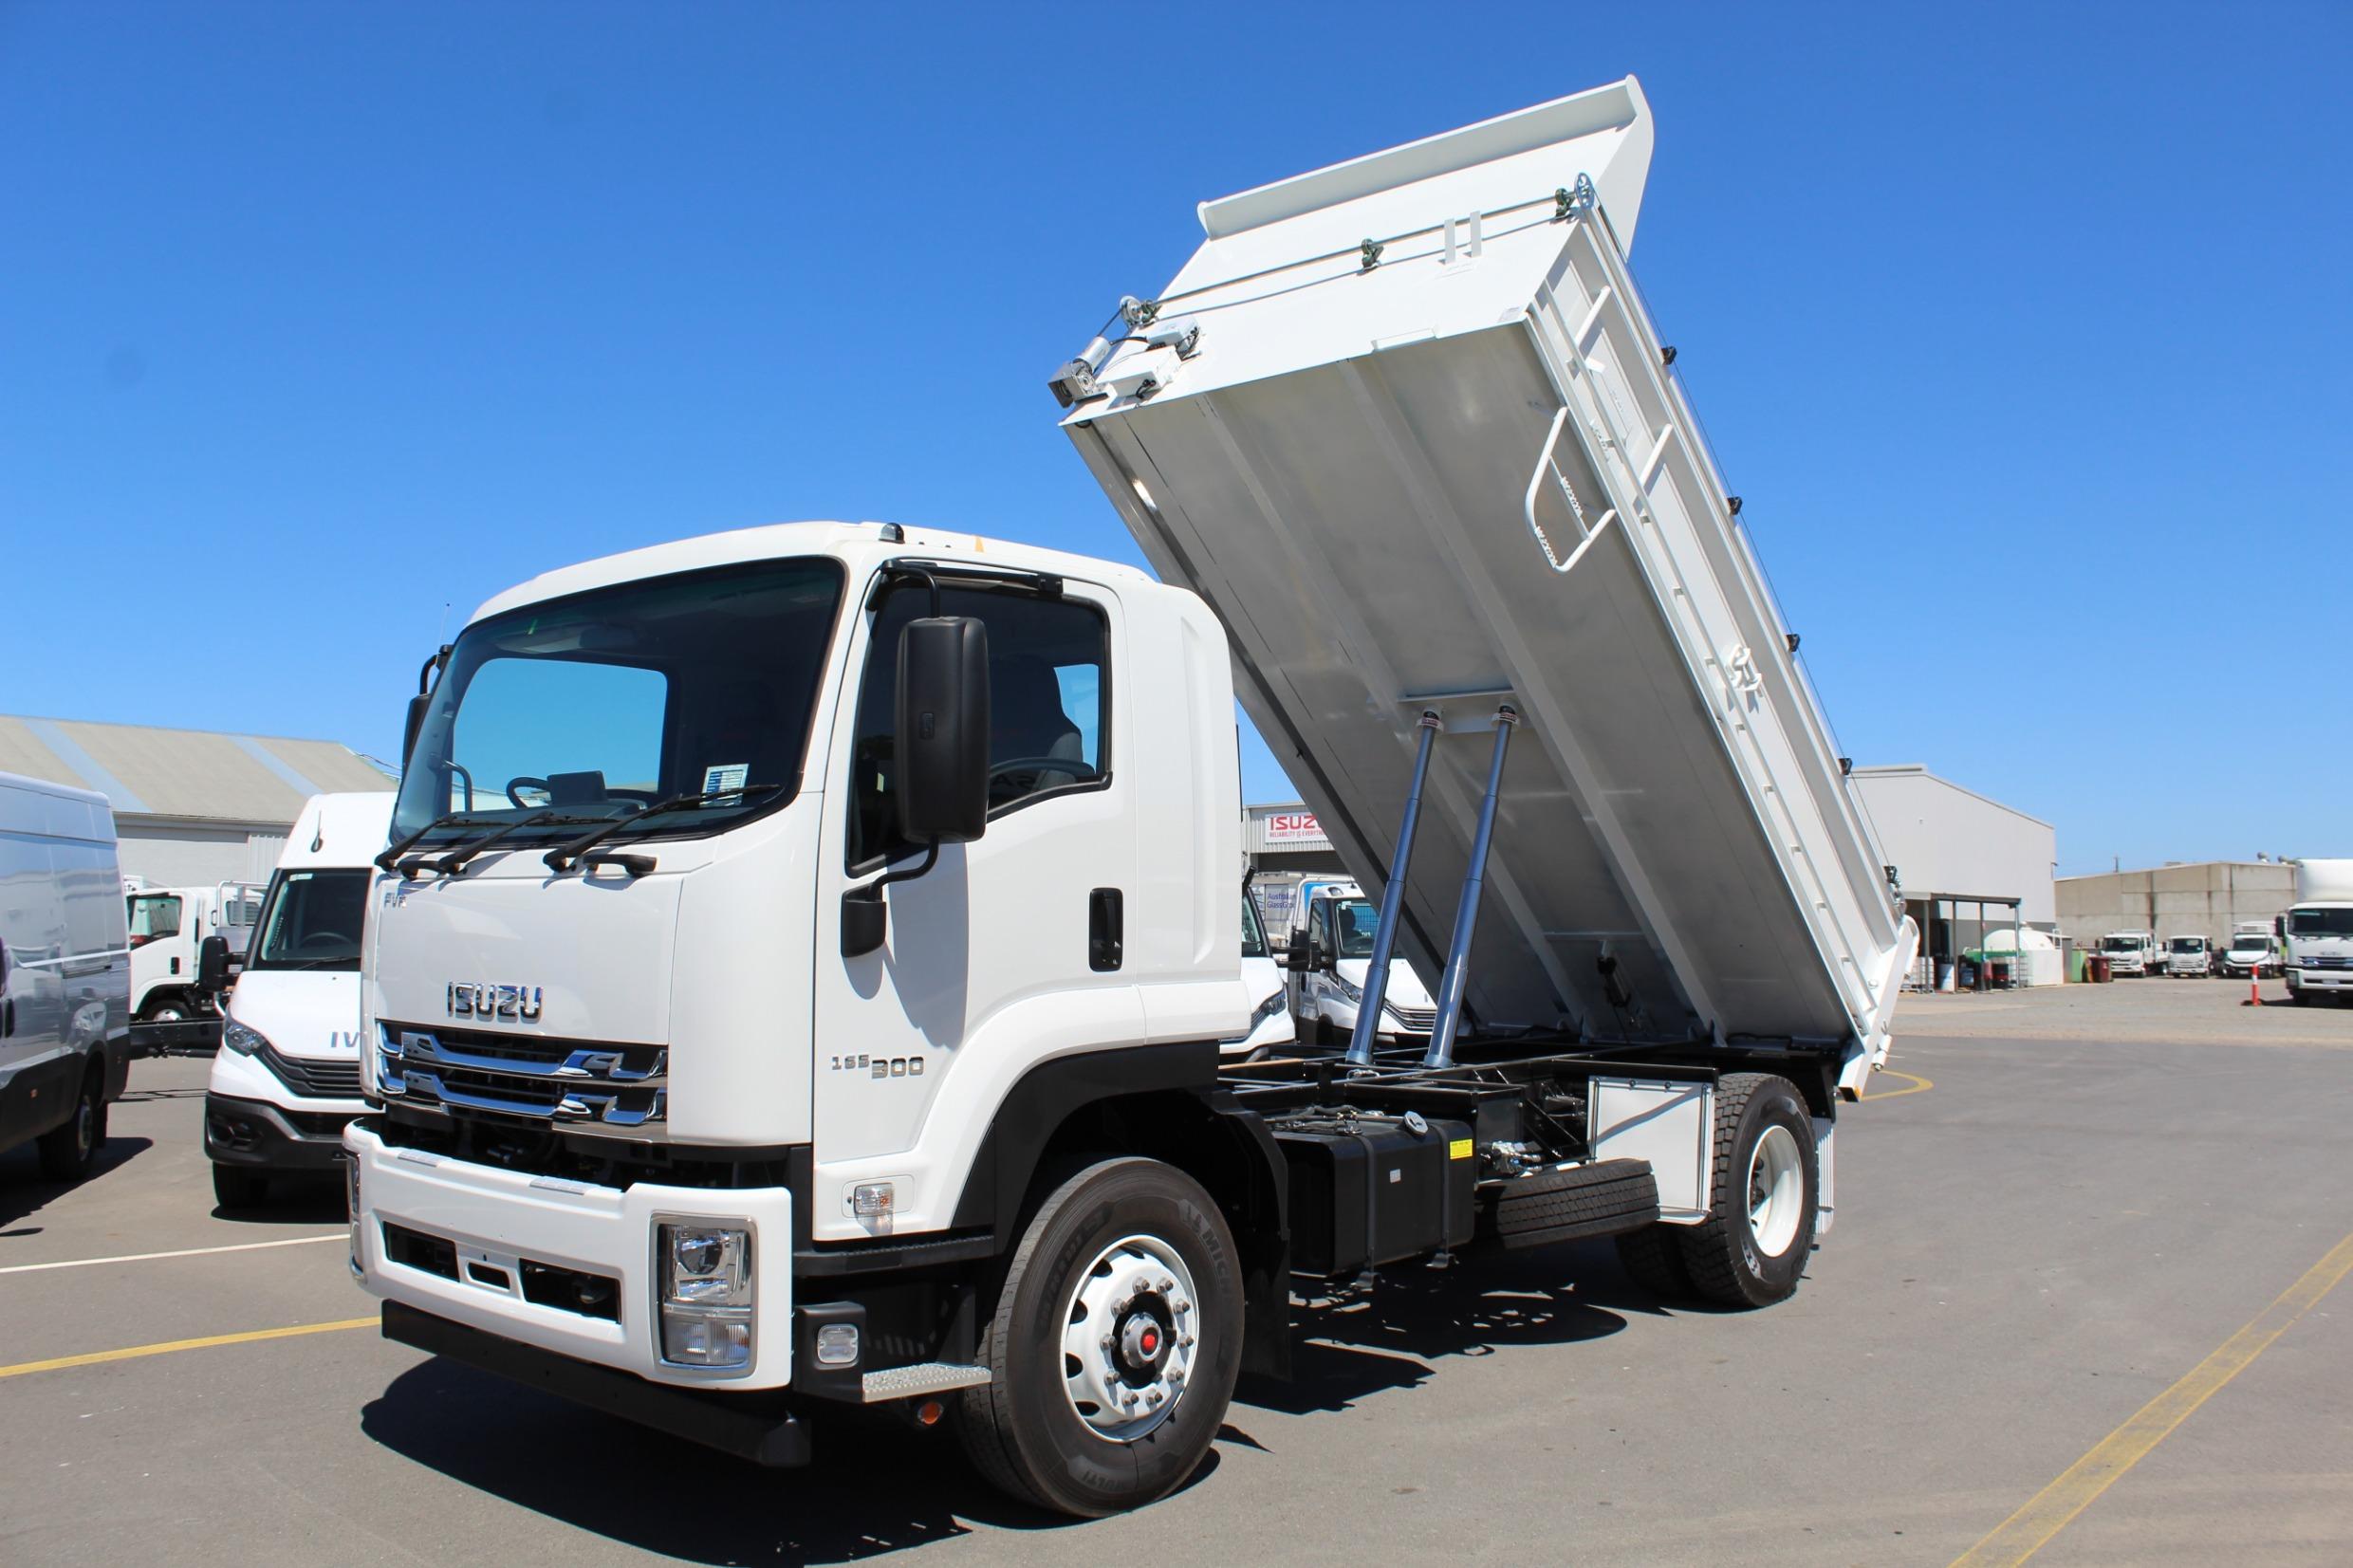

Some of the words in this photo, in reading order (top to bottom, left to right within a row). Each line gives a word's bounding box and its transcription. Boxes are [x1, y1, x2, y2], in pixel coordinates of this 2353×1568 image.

[1270, 814, 1317, 830] ISUZ
[446, 982, 544, 1022] ISUZU
[330, 1031, 361, 1048] IV
[831, 1054, 870, 1070] 165
[871, 1056, 925, 1079] 300
